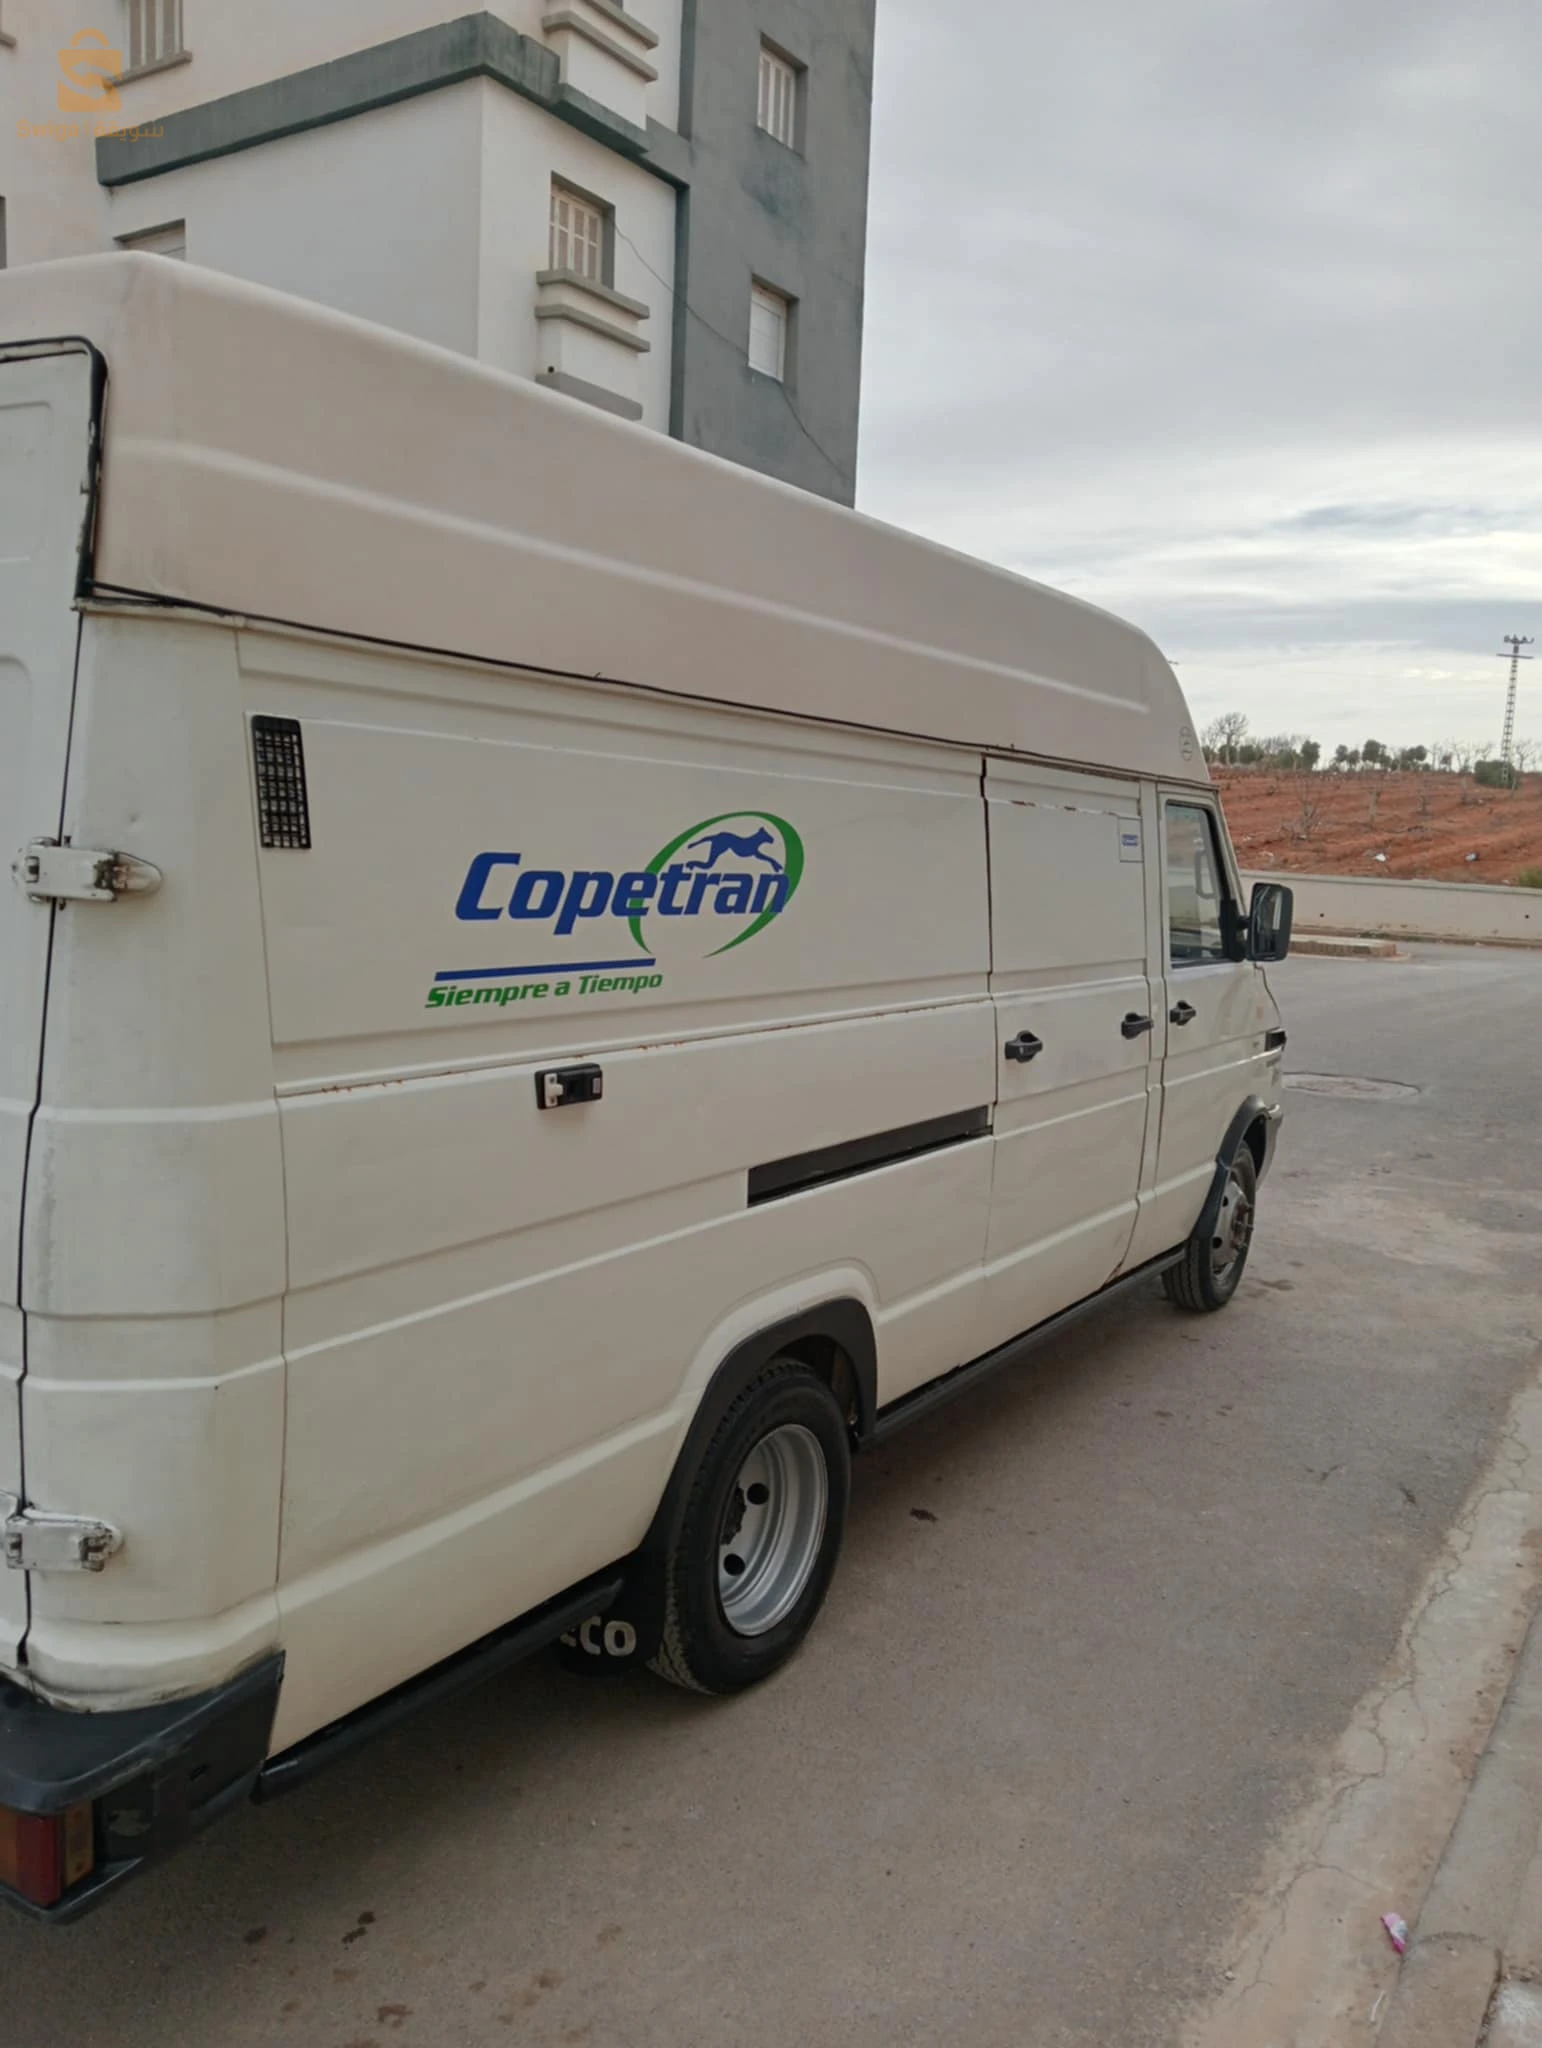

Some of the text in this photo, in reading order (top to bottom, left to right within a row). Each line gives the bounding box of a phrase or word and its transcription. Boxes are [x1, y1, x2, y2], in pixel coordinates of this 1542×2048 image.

[455, 851, 792, 936] Copetran
[425, 973, 663, 1008] Siempre a Tiempo
[560, 1615, 637, 1657] CO
